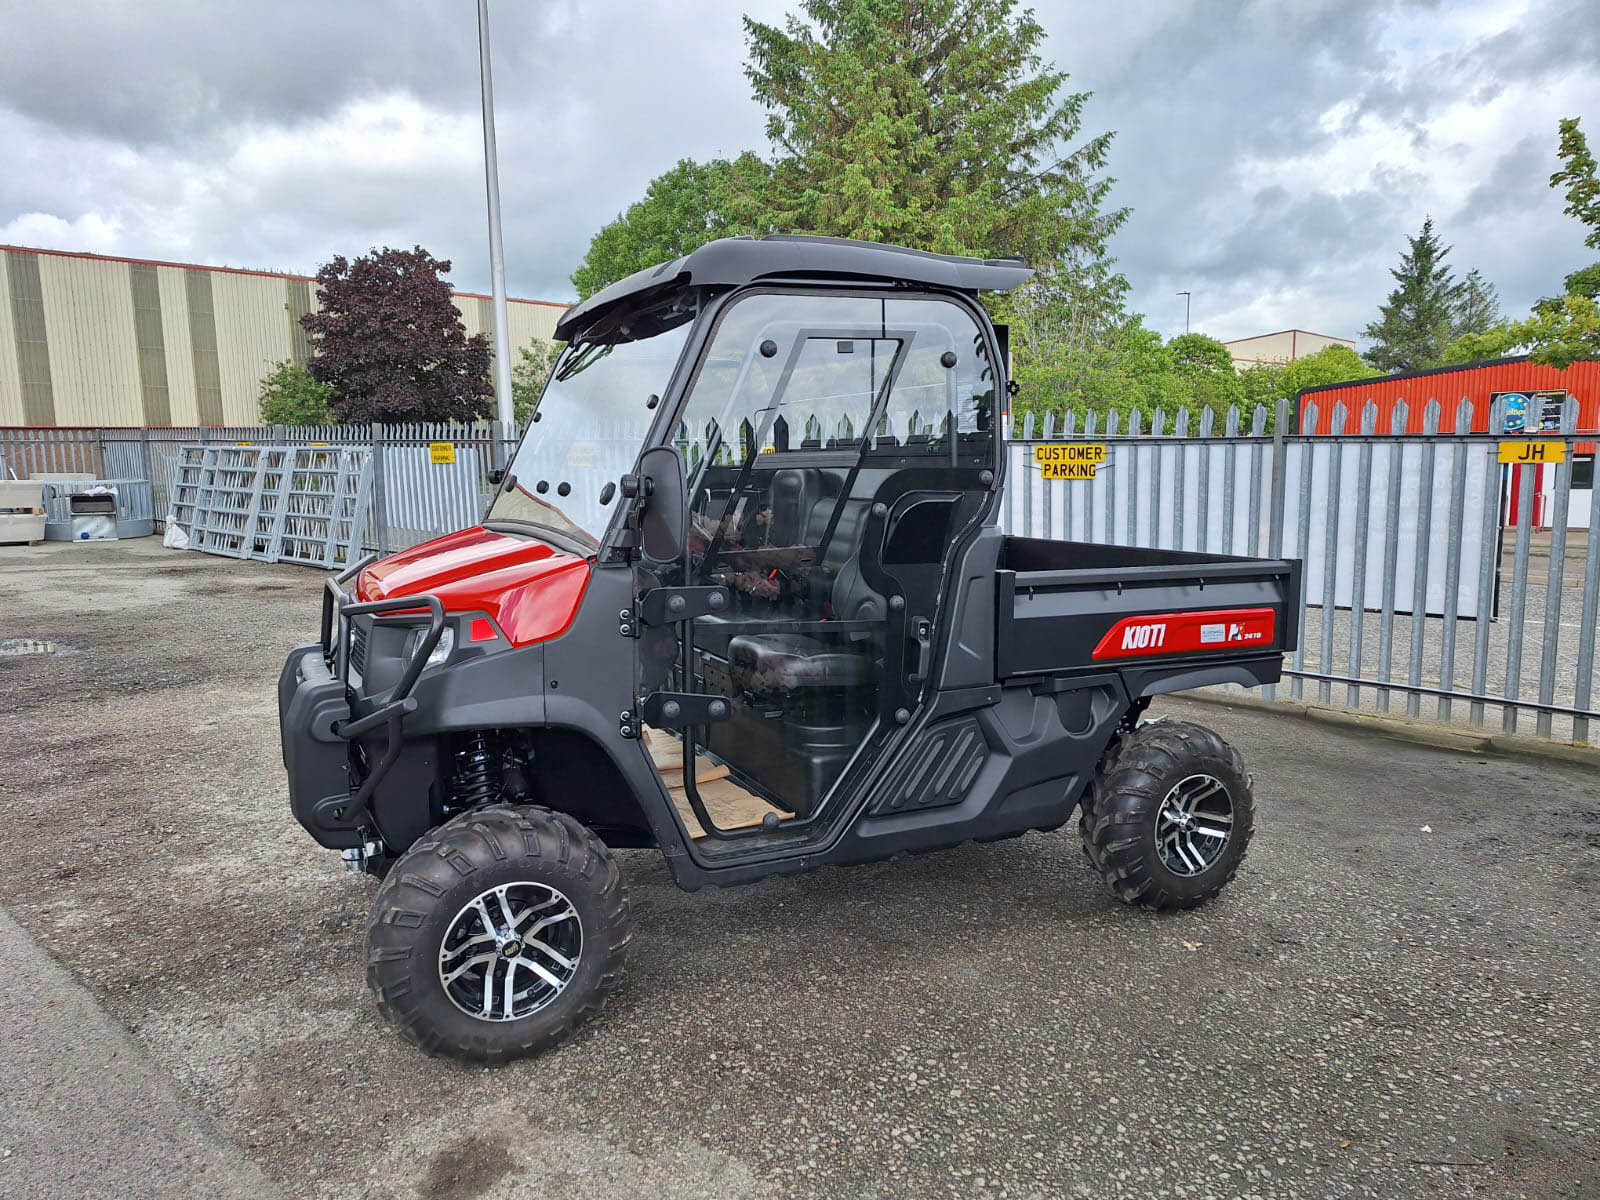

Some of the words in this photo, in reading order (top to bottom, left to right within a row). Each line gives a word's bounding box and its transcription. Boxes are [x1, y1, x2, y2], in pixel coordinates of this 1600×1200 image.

[1036, 447, 1103, 460] CUSTOMER
[1517, 443, 1545, 460] JH
[1043, 463, 1097, 477] PARKING
[1120, 623, 1167, 650] KIOTI
